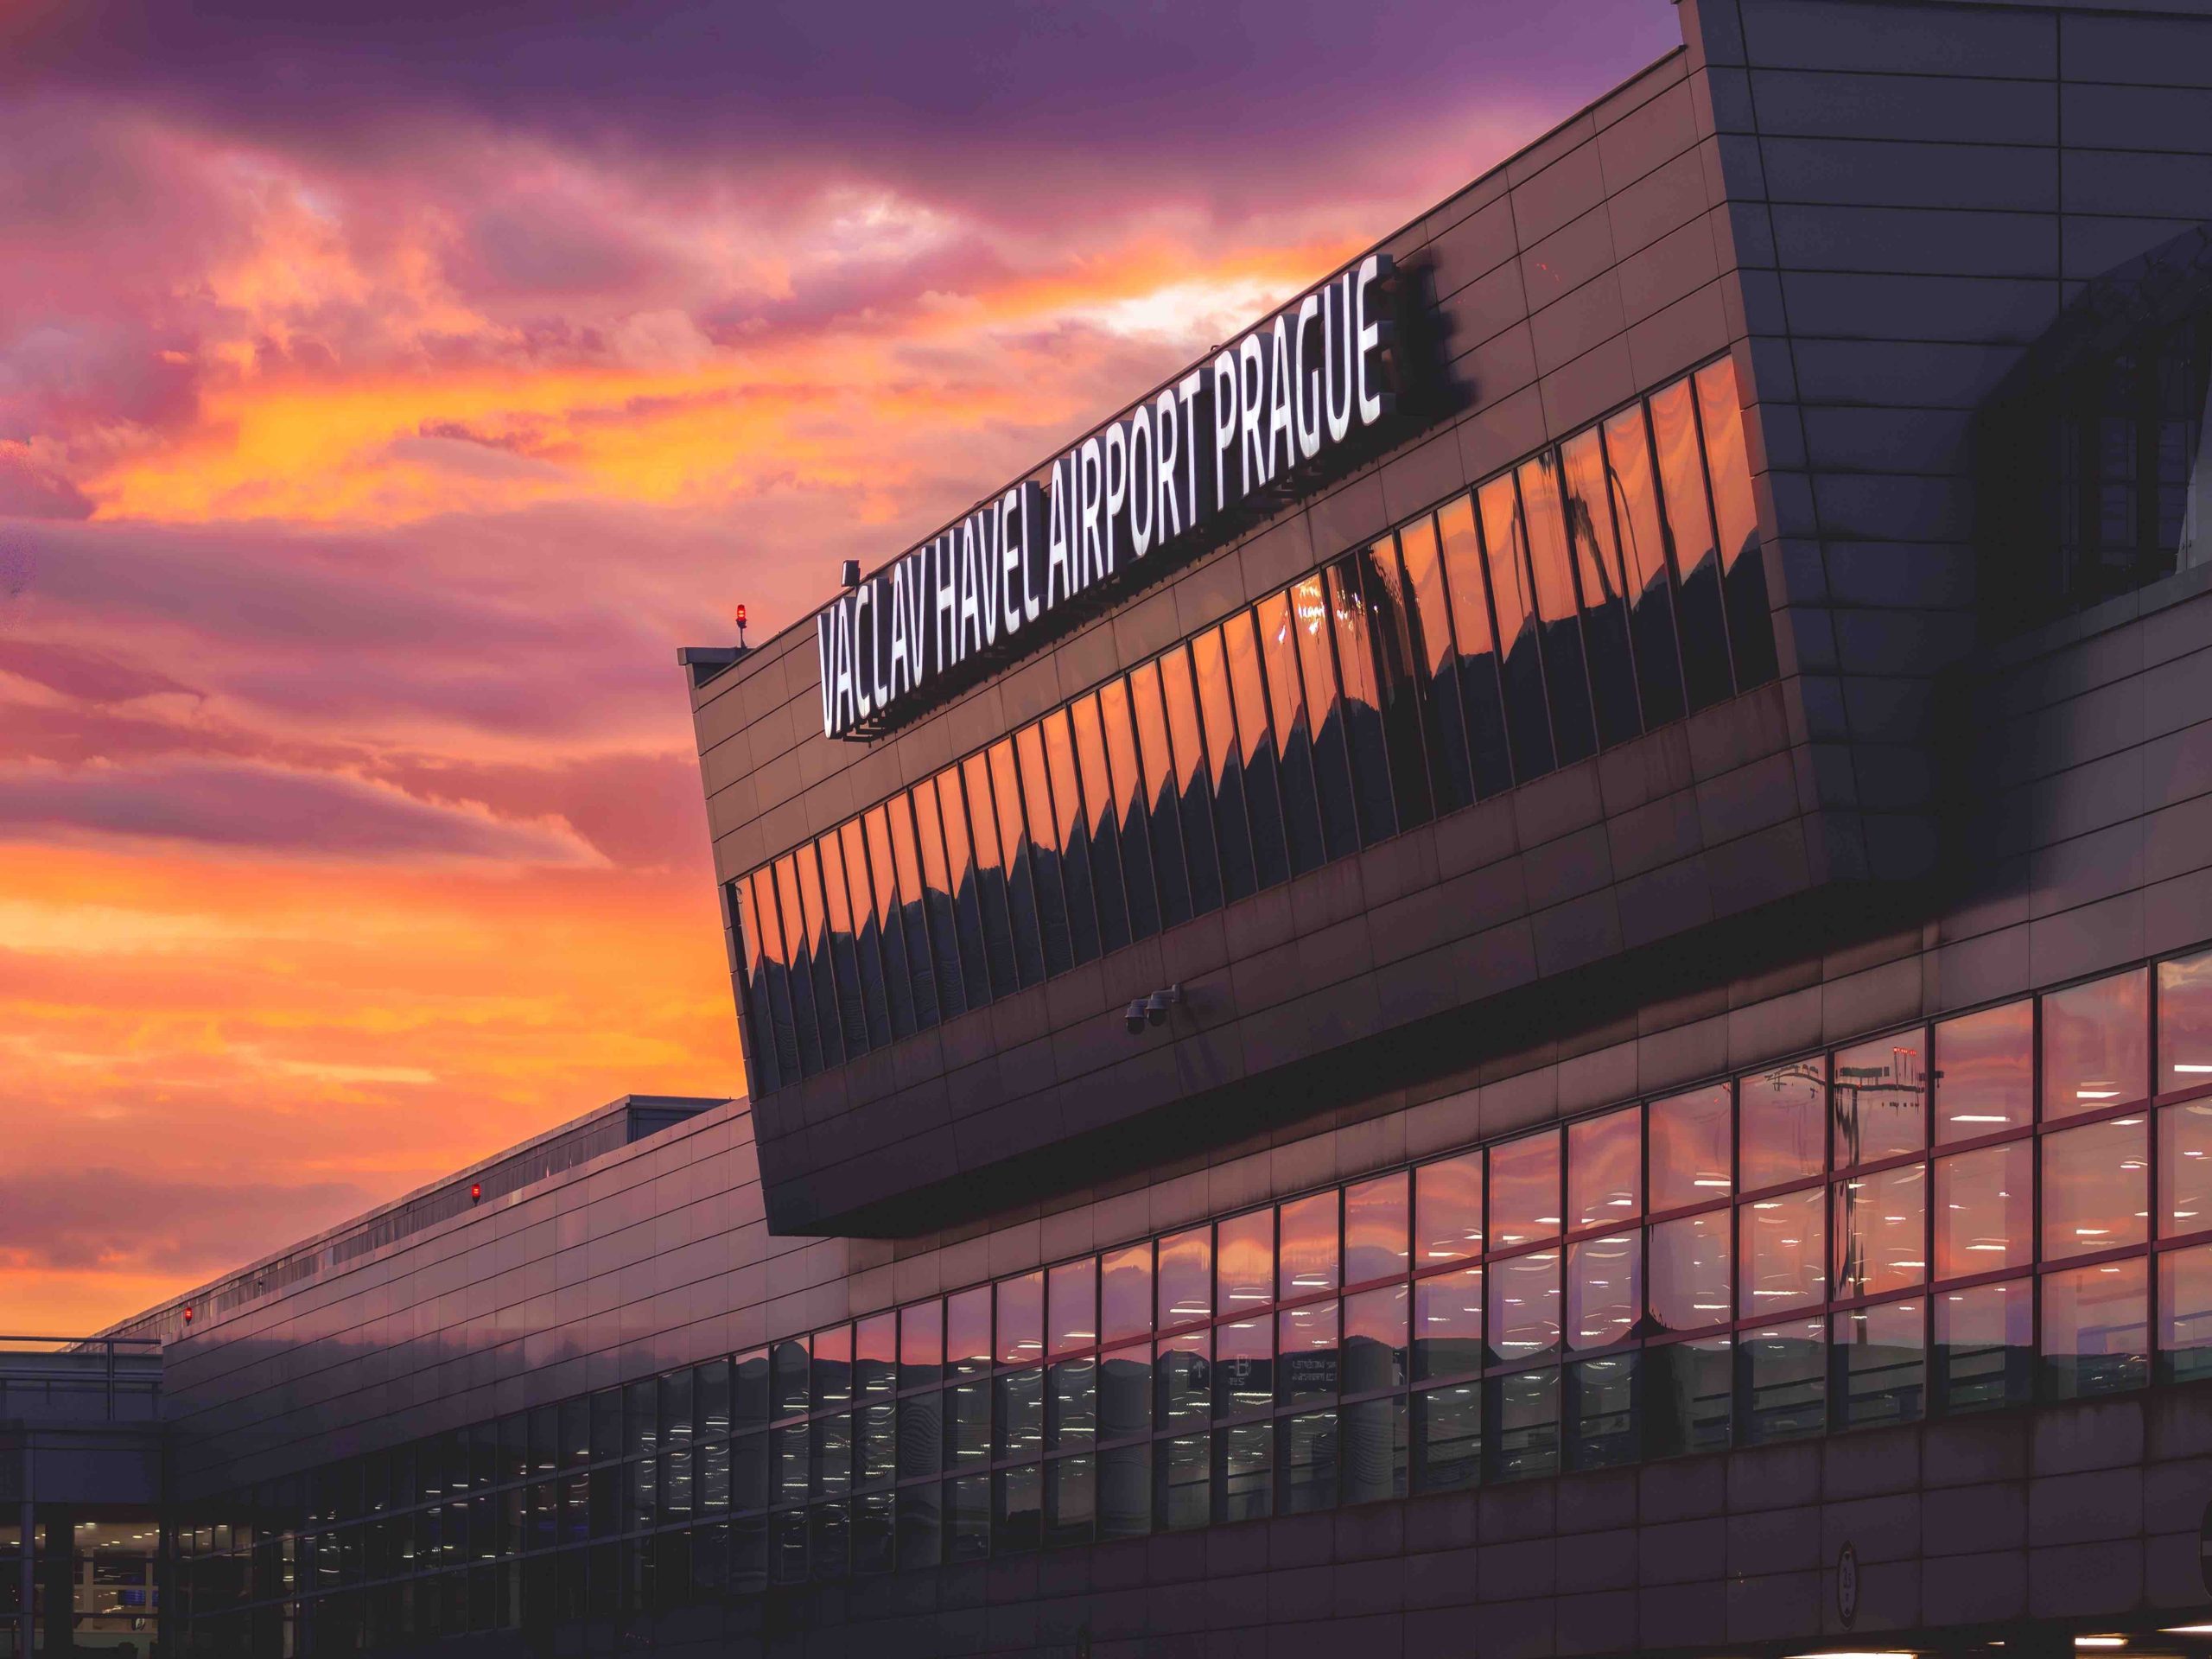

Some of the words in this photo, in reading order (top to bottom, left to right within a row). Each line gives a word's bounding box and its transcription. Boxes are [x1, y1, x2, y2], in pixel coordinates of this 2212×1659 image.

[935, 481, 1039, 675] HAVEL
[1046, 369, 1201, 611] AIRPORT
[1214, 255, 1381, 512] PRAGUE
